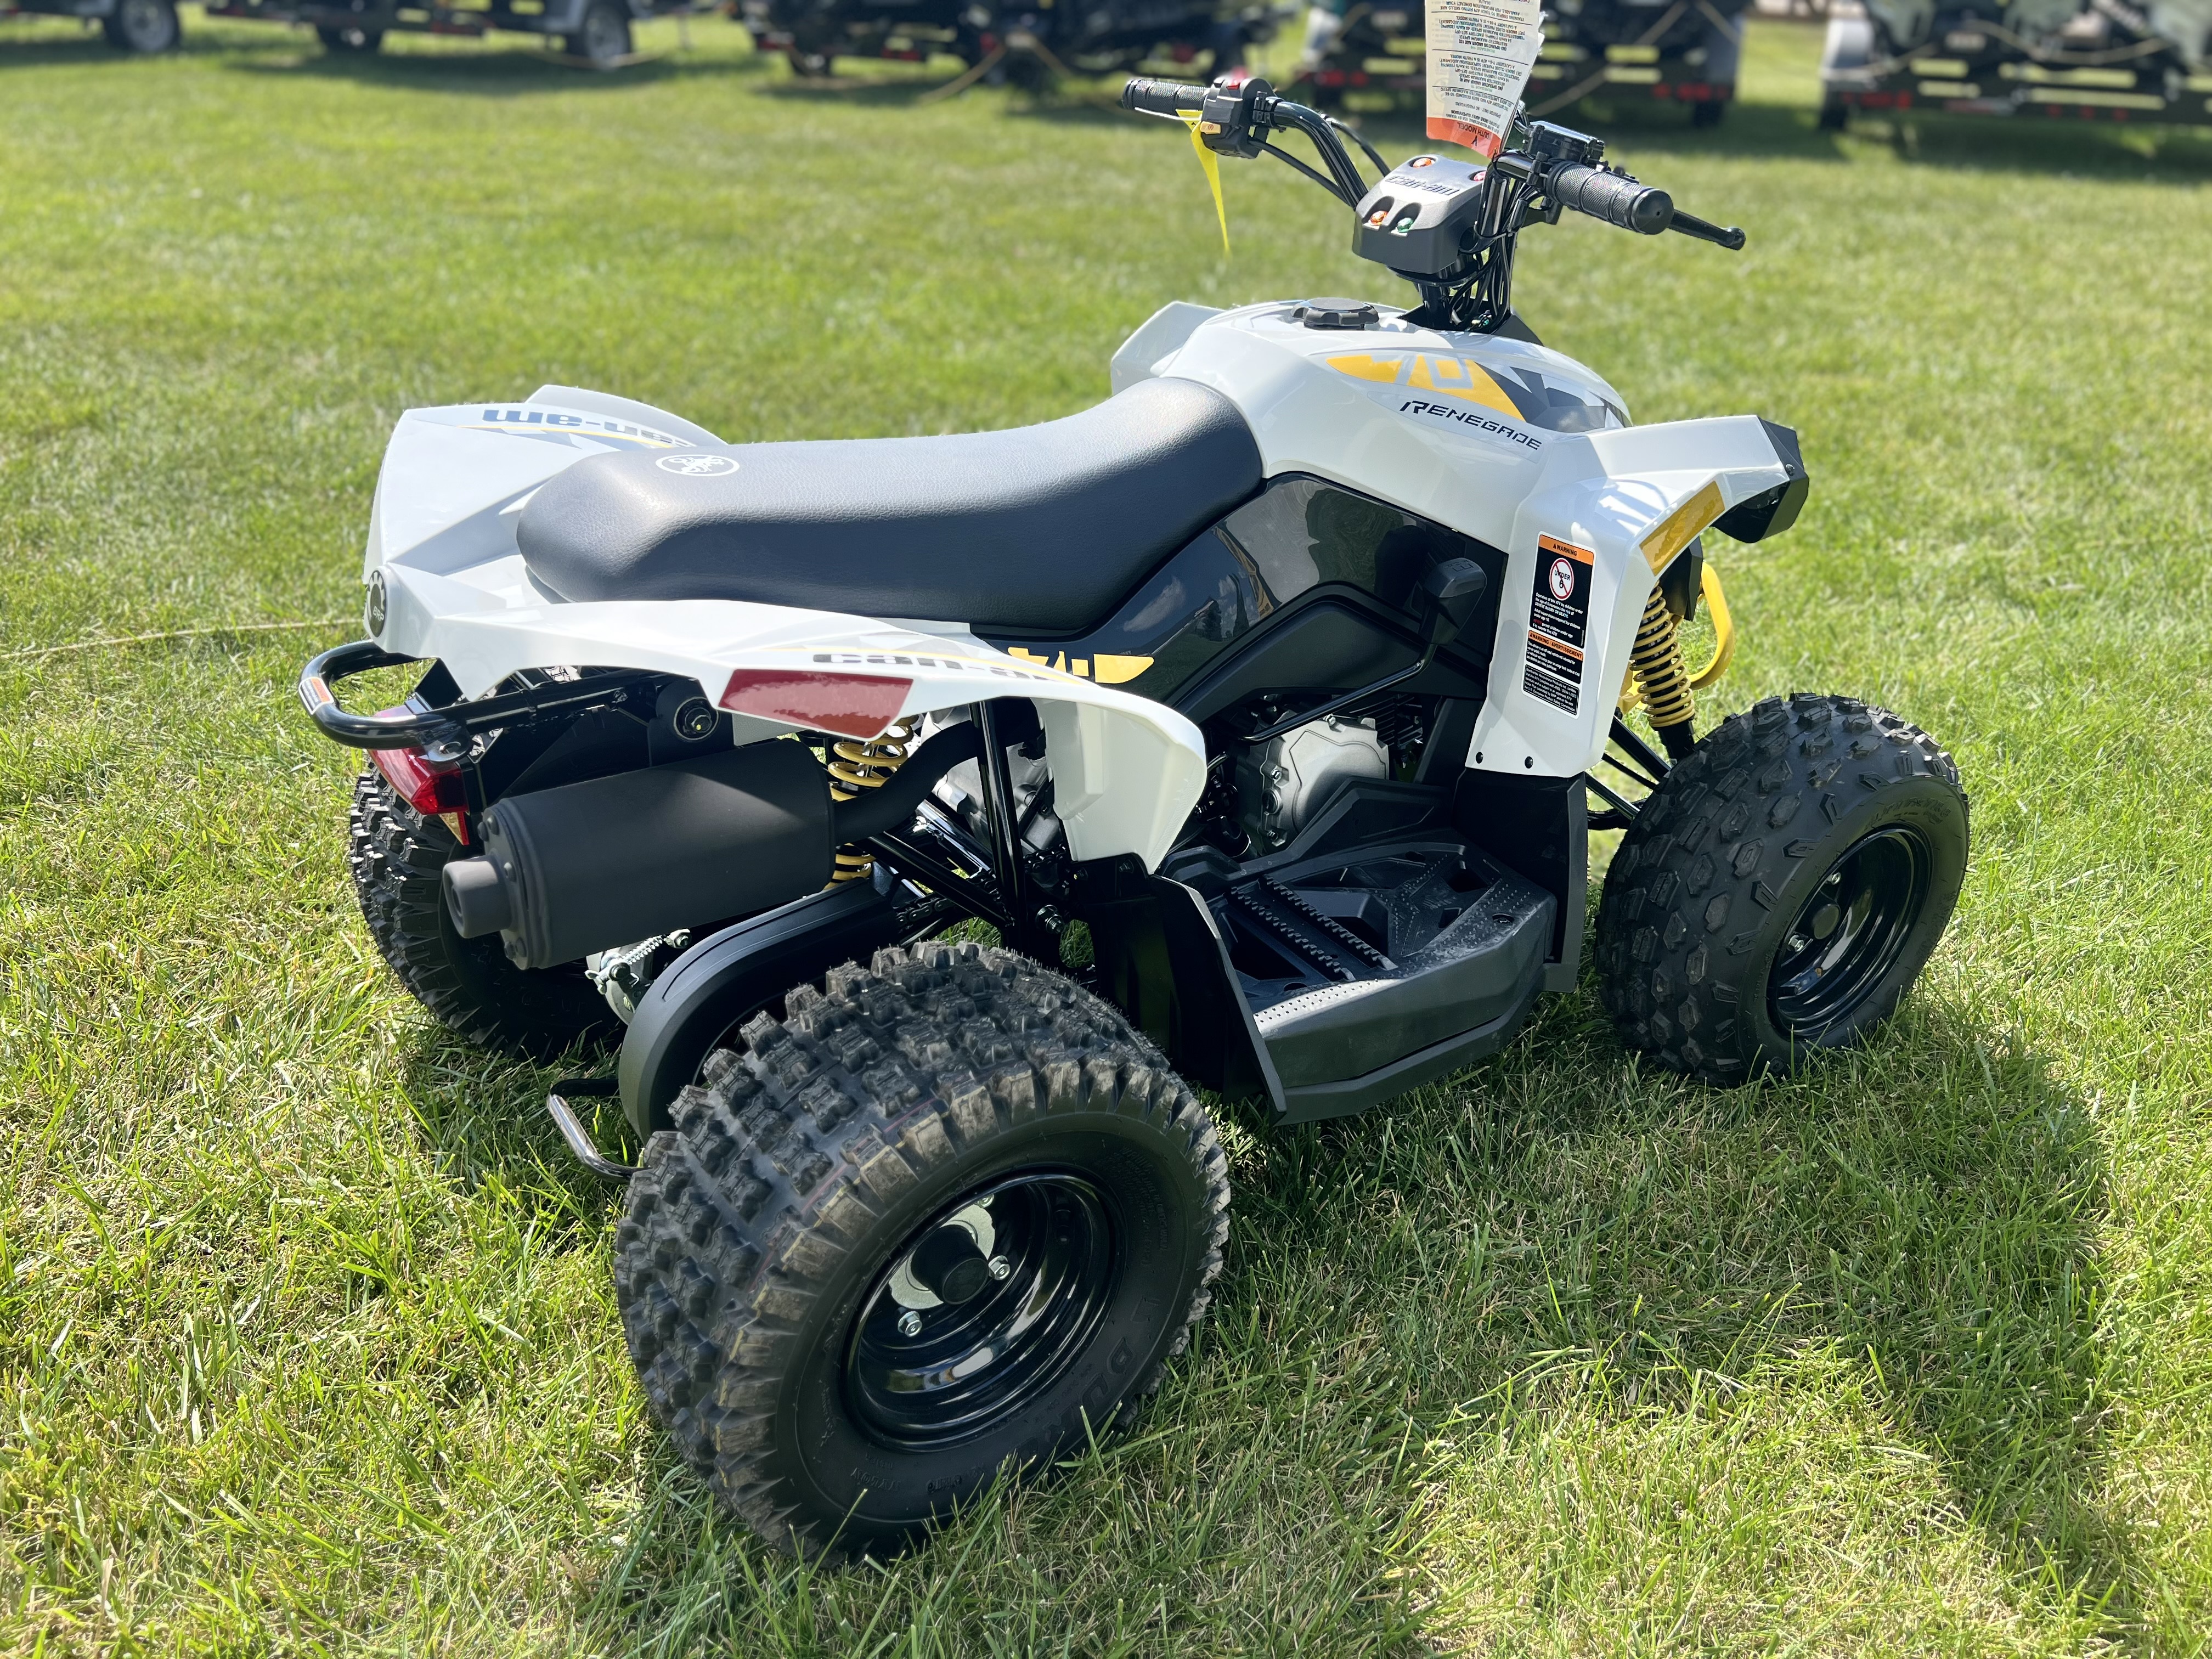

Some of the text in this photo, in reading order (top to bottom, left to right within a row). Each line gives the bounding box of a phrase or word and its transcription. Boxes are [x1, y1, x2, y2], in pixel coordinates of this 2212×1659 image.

[1457, 122, 1477, 134] MODEL
[1385, 174, 1460, 195] can-am
[1400, 400, 1542, 450] RENEGADE
[1556, 544, 1577, 556] WARNING
[1554, 570, 1570, 580] UNDER
[1559, 580, 1564, 589] 6
[373, 605, 385, 622] BRP
[1532, 634, 1548, 644] WARNING
[1551, 641, 1582, 658] AVERTISSEMENT
[814, 653, 1059, 681] can-a
